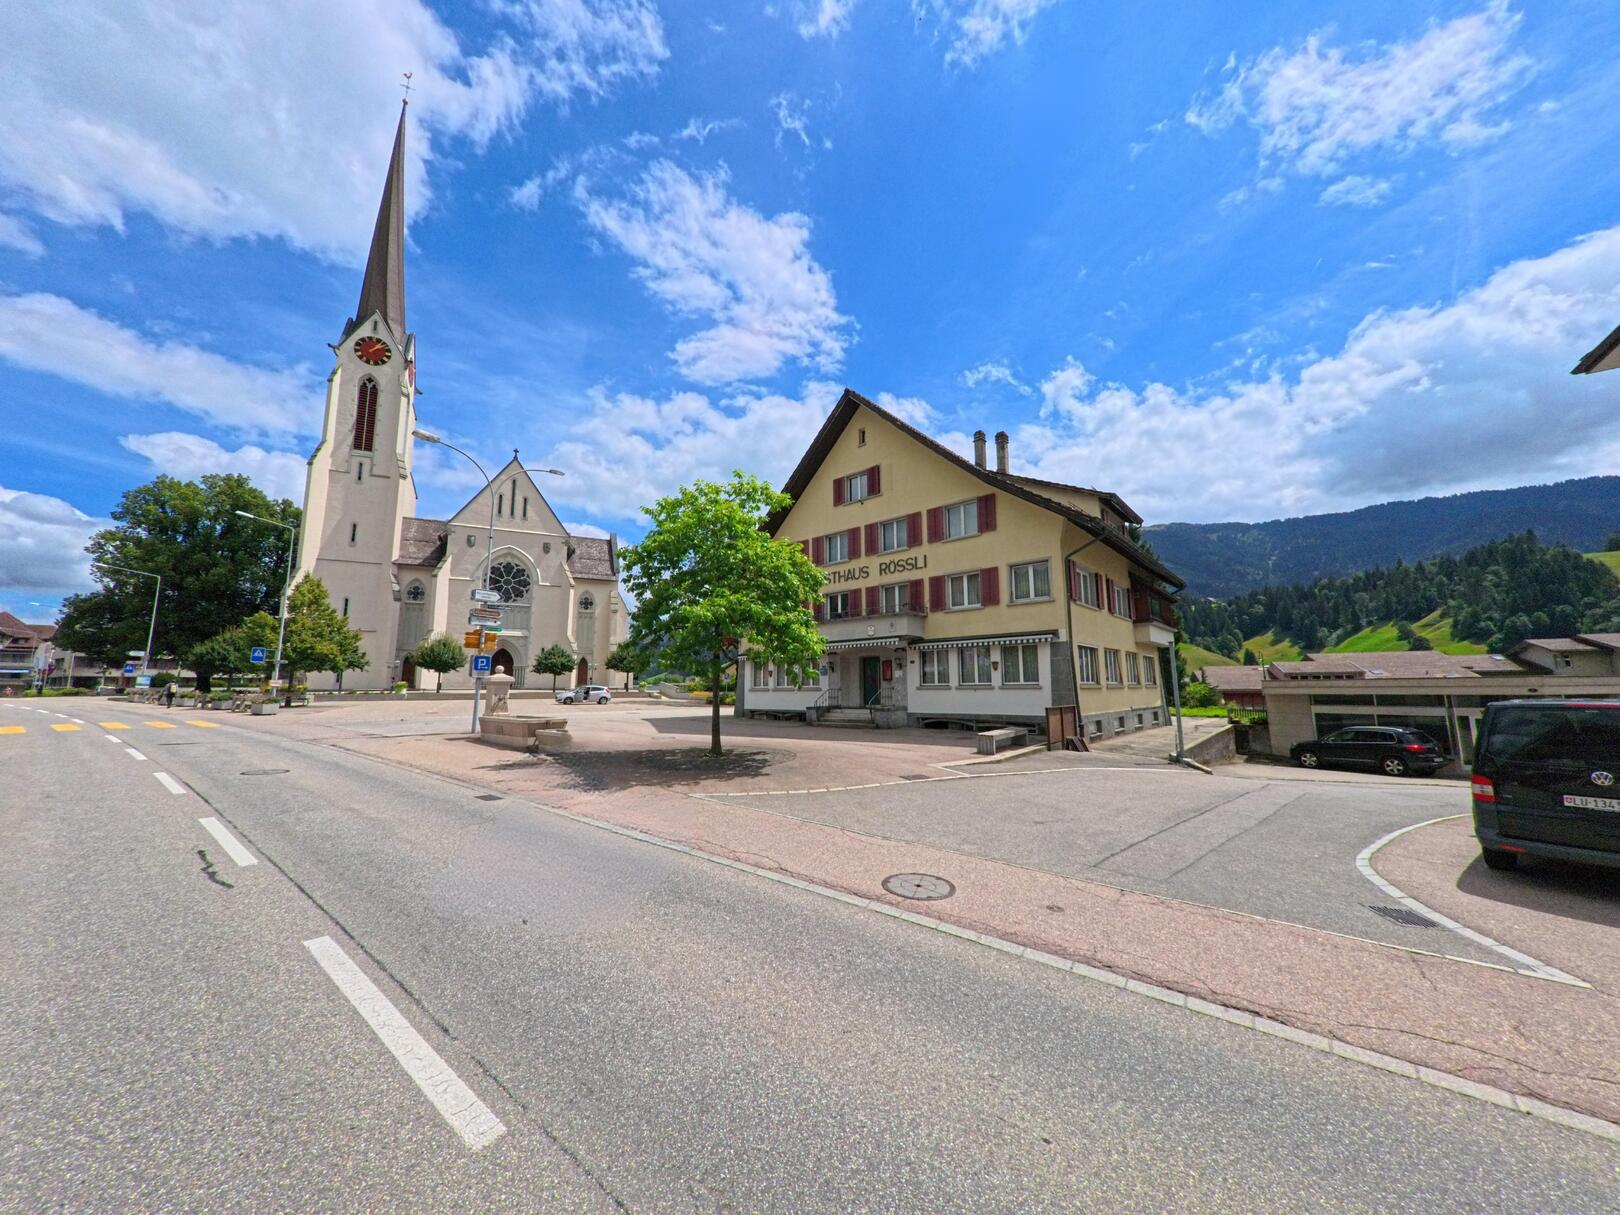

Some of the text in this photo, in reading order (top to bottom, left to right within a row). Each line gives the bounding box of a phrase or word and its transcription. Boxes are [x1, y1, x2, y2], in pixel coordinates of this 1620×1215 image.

[825, 554, 928, 584] STHAUS RÖSSLI
[478, 658, 486, 670] P
